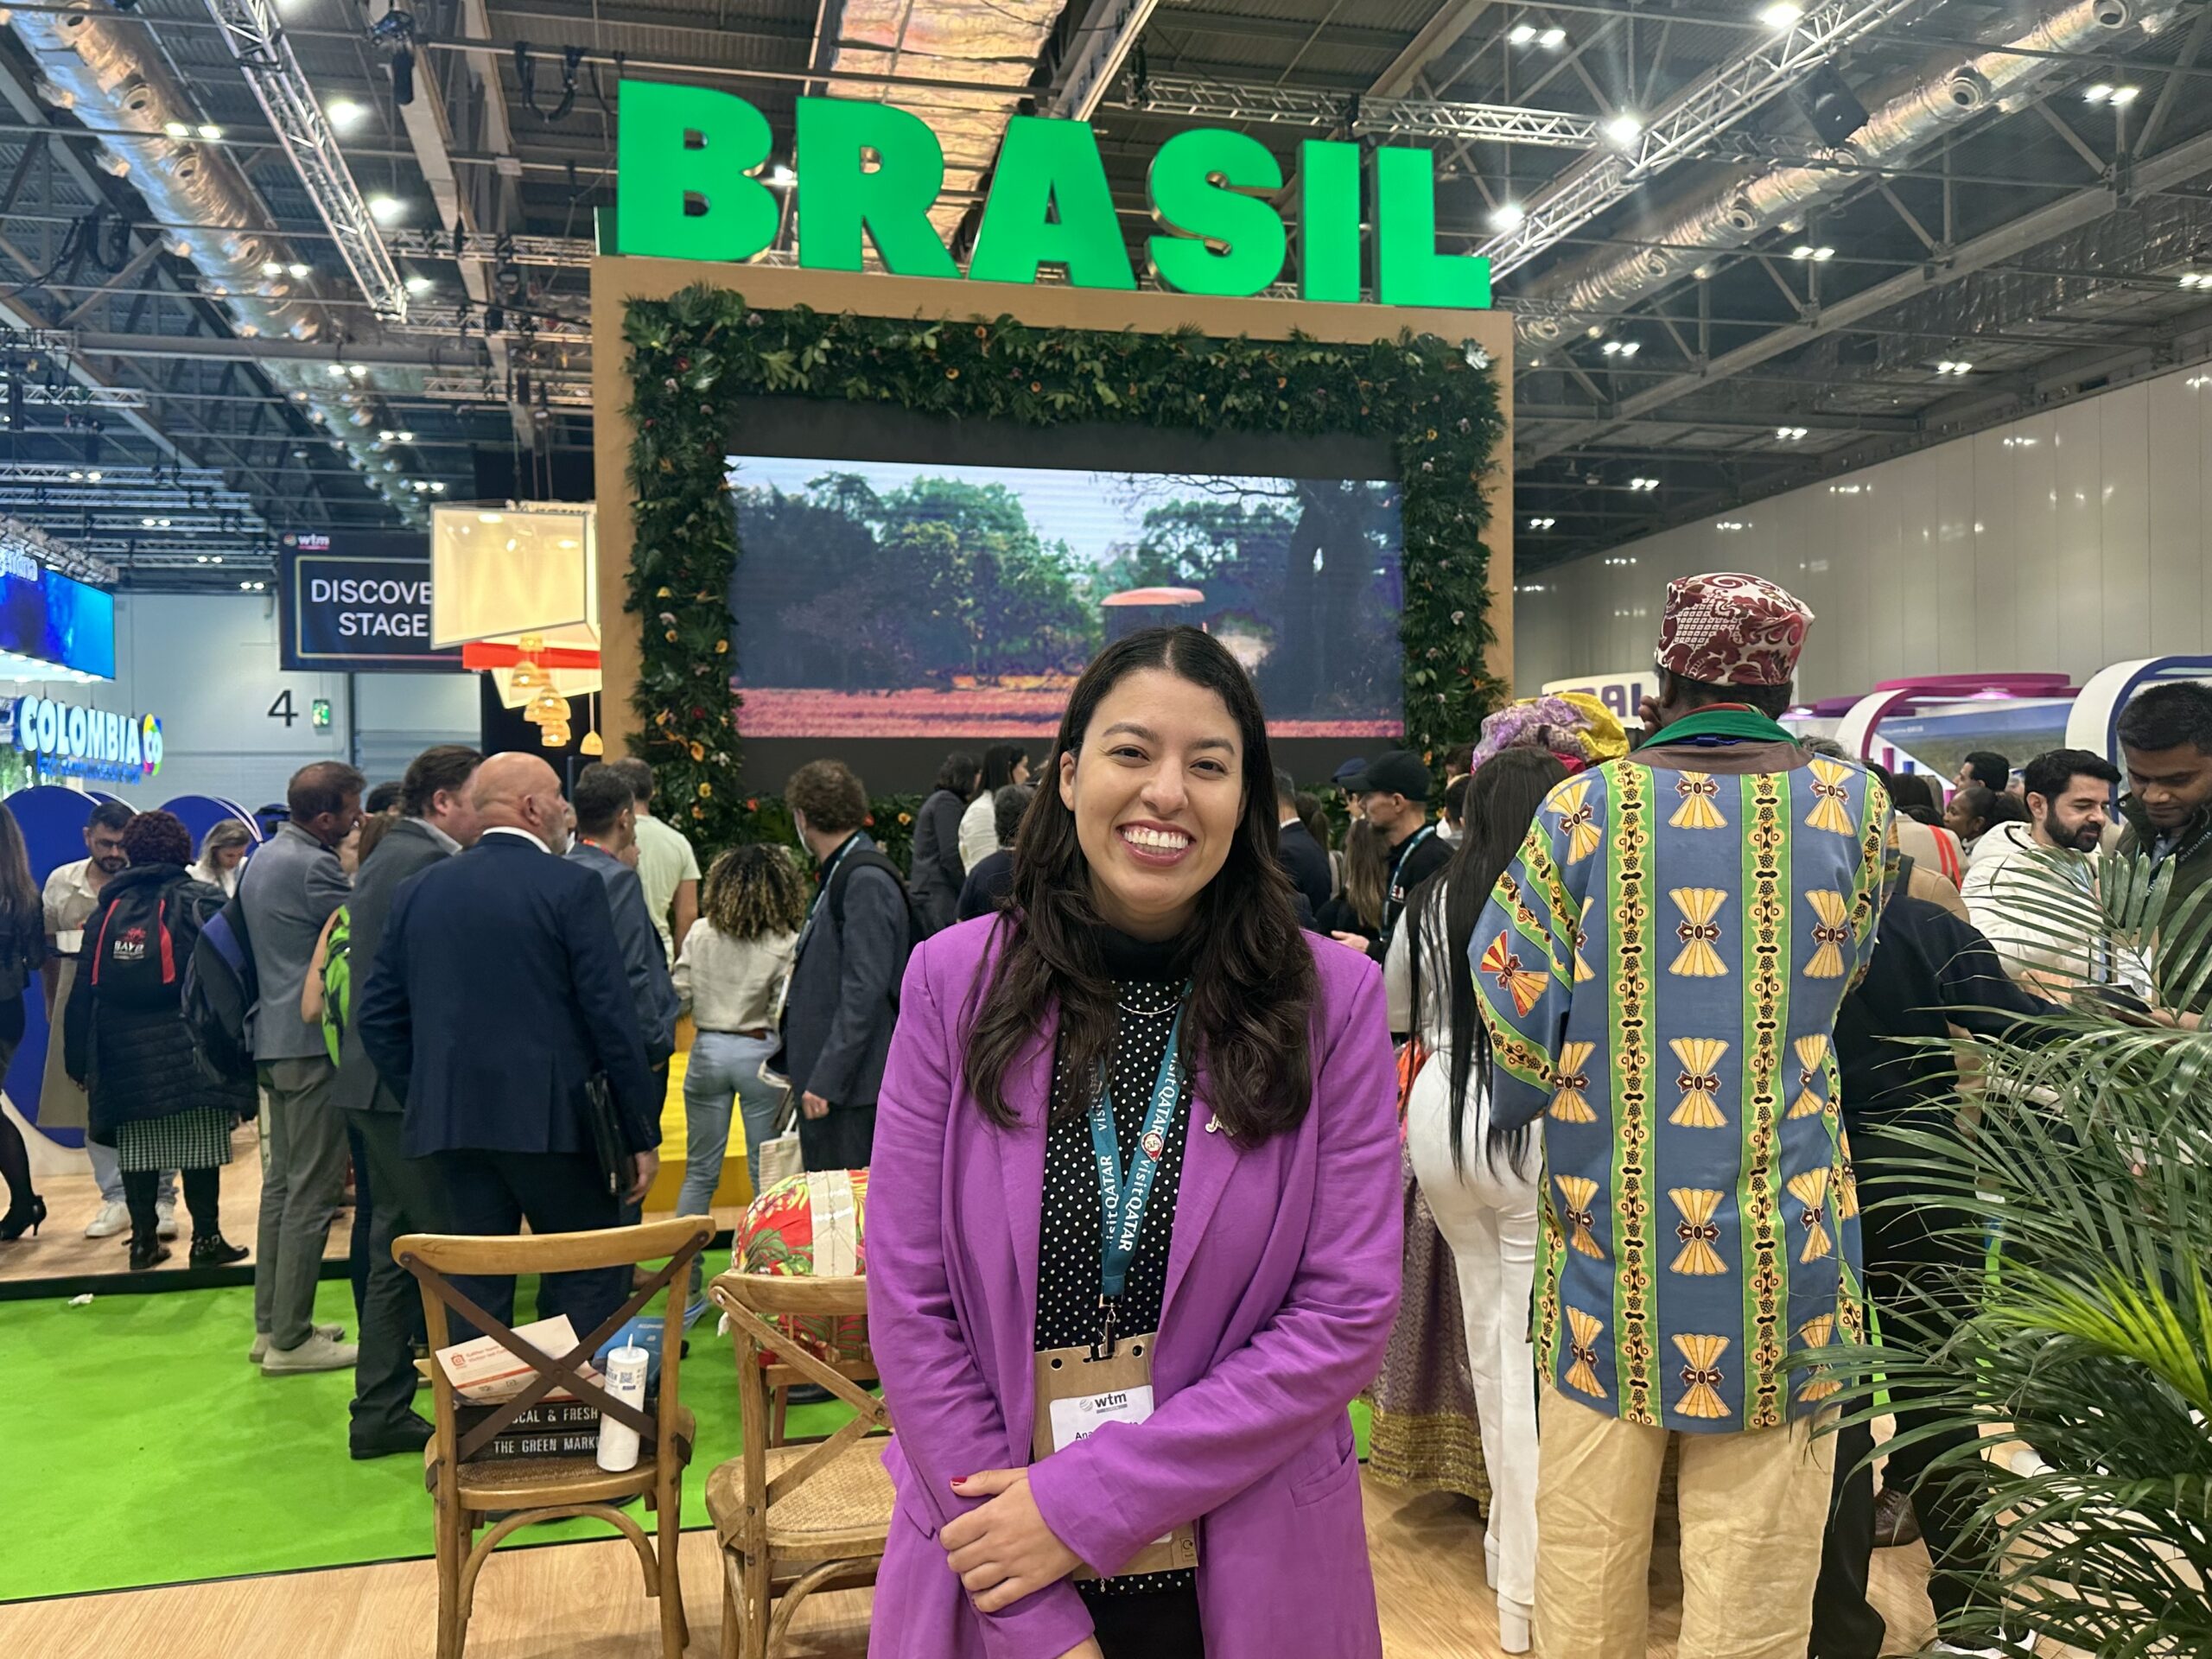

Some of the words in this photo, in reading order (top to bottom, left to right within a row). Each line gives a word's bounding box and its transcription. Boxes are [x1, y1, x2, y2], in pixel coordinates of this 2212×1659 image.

[618, 79, 1491, 308] BRASIL
[298, 534, 330, 546] wtm
[339, 612, 429, 637] STAGE
[268, 690, 299, 727] 4
[20, 694, 141, 766] COLOMBIA
[1099, 1155, 1120, 1243] isitQATAR
[1118, 1160, 1151, 1252] visitQATAR
[547, 1409, 556, 1422] &
[563, 1407, 598, 1421] FRESH
[1094, 1393, 1127, 1408] wtm
[493, 1440, 514, 1453] THE
[521, 1438, 556, 1452] GREEN
